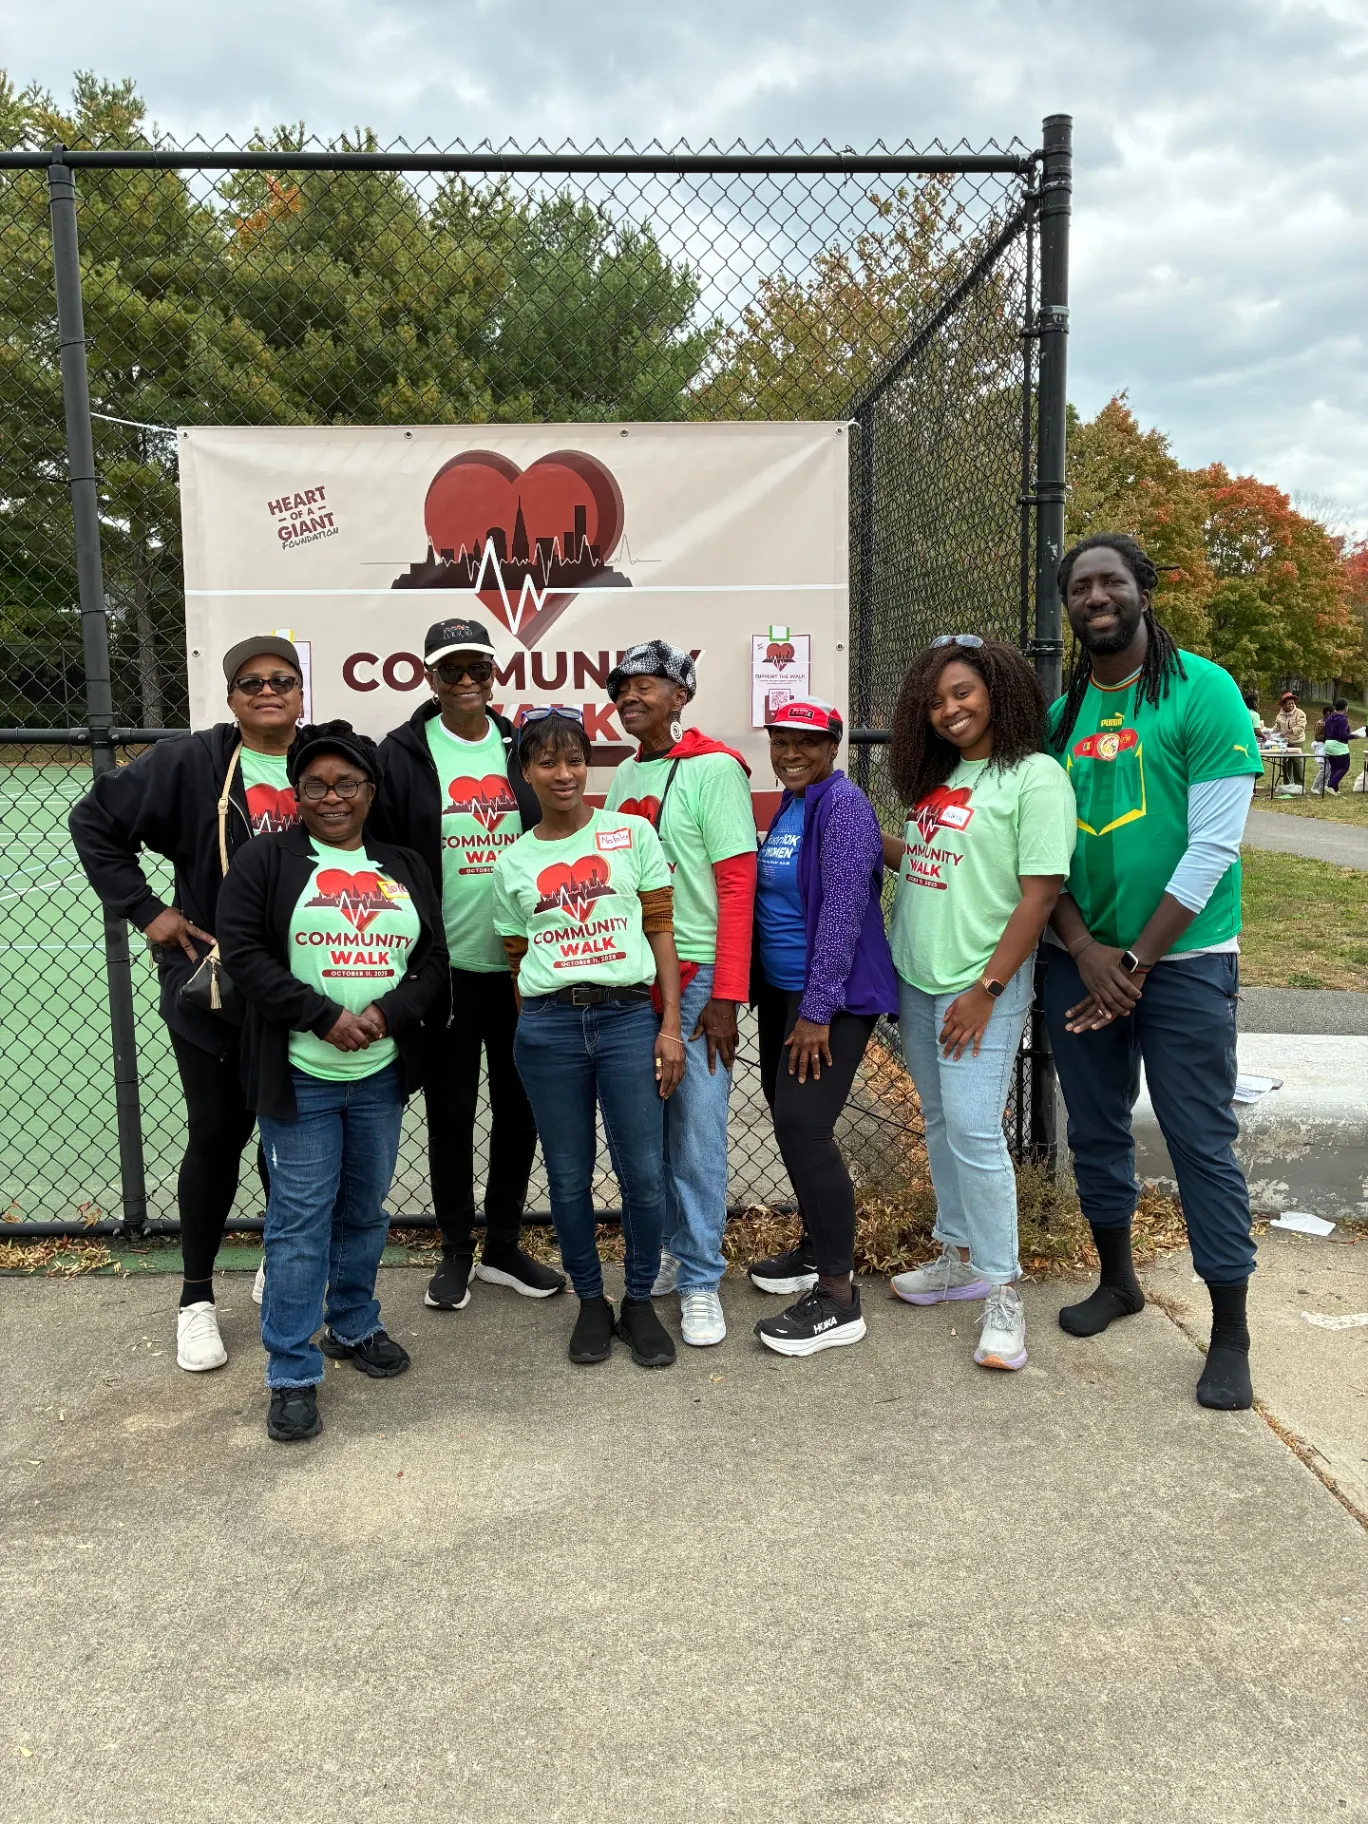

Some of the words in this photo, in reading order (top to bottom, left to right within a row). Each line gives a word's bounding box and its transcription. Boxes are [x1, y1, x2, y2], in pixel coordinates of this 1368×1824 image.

[267, 485, 326, 516] HEART
[289, 510, 304, 521] OF
[307, 507, 315, 517] A
[277, 512, 334, 543] GIANT
[281, 526, 339, 550] FOUNDATION
[342, 650, 703, 693] COMUN
[1101, 718, 1122, 728] PUMA
[441, 833, 520, 849] OMMUN
[465, 850, 503, 864] WA
[906, 843, 964, 867] MMUNITY
[909, 858, 942, 879] WALK
[295, 931, 413, 949] COMMUNITY
[533, 917, 628, 944] COMMUNITY
[560, 936, 617, 957] WALK
[331, 951, 389, 965] WALK
[561, 959, 591, 967] OCTOBER
[813, 1316, 838, 1335] HOKA
